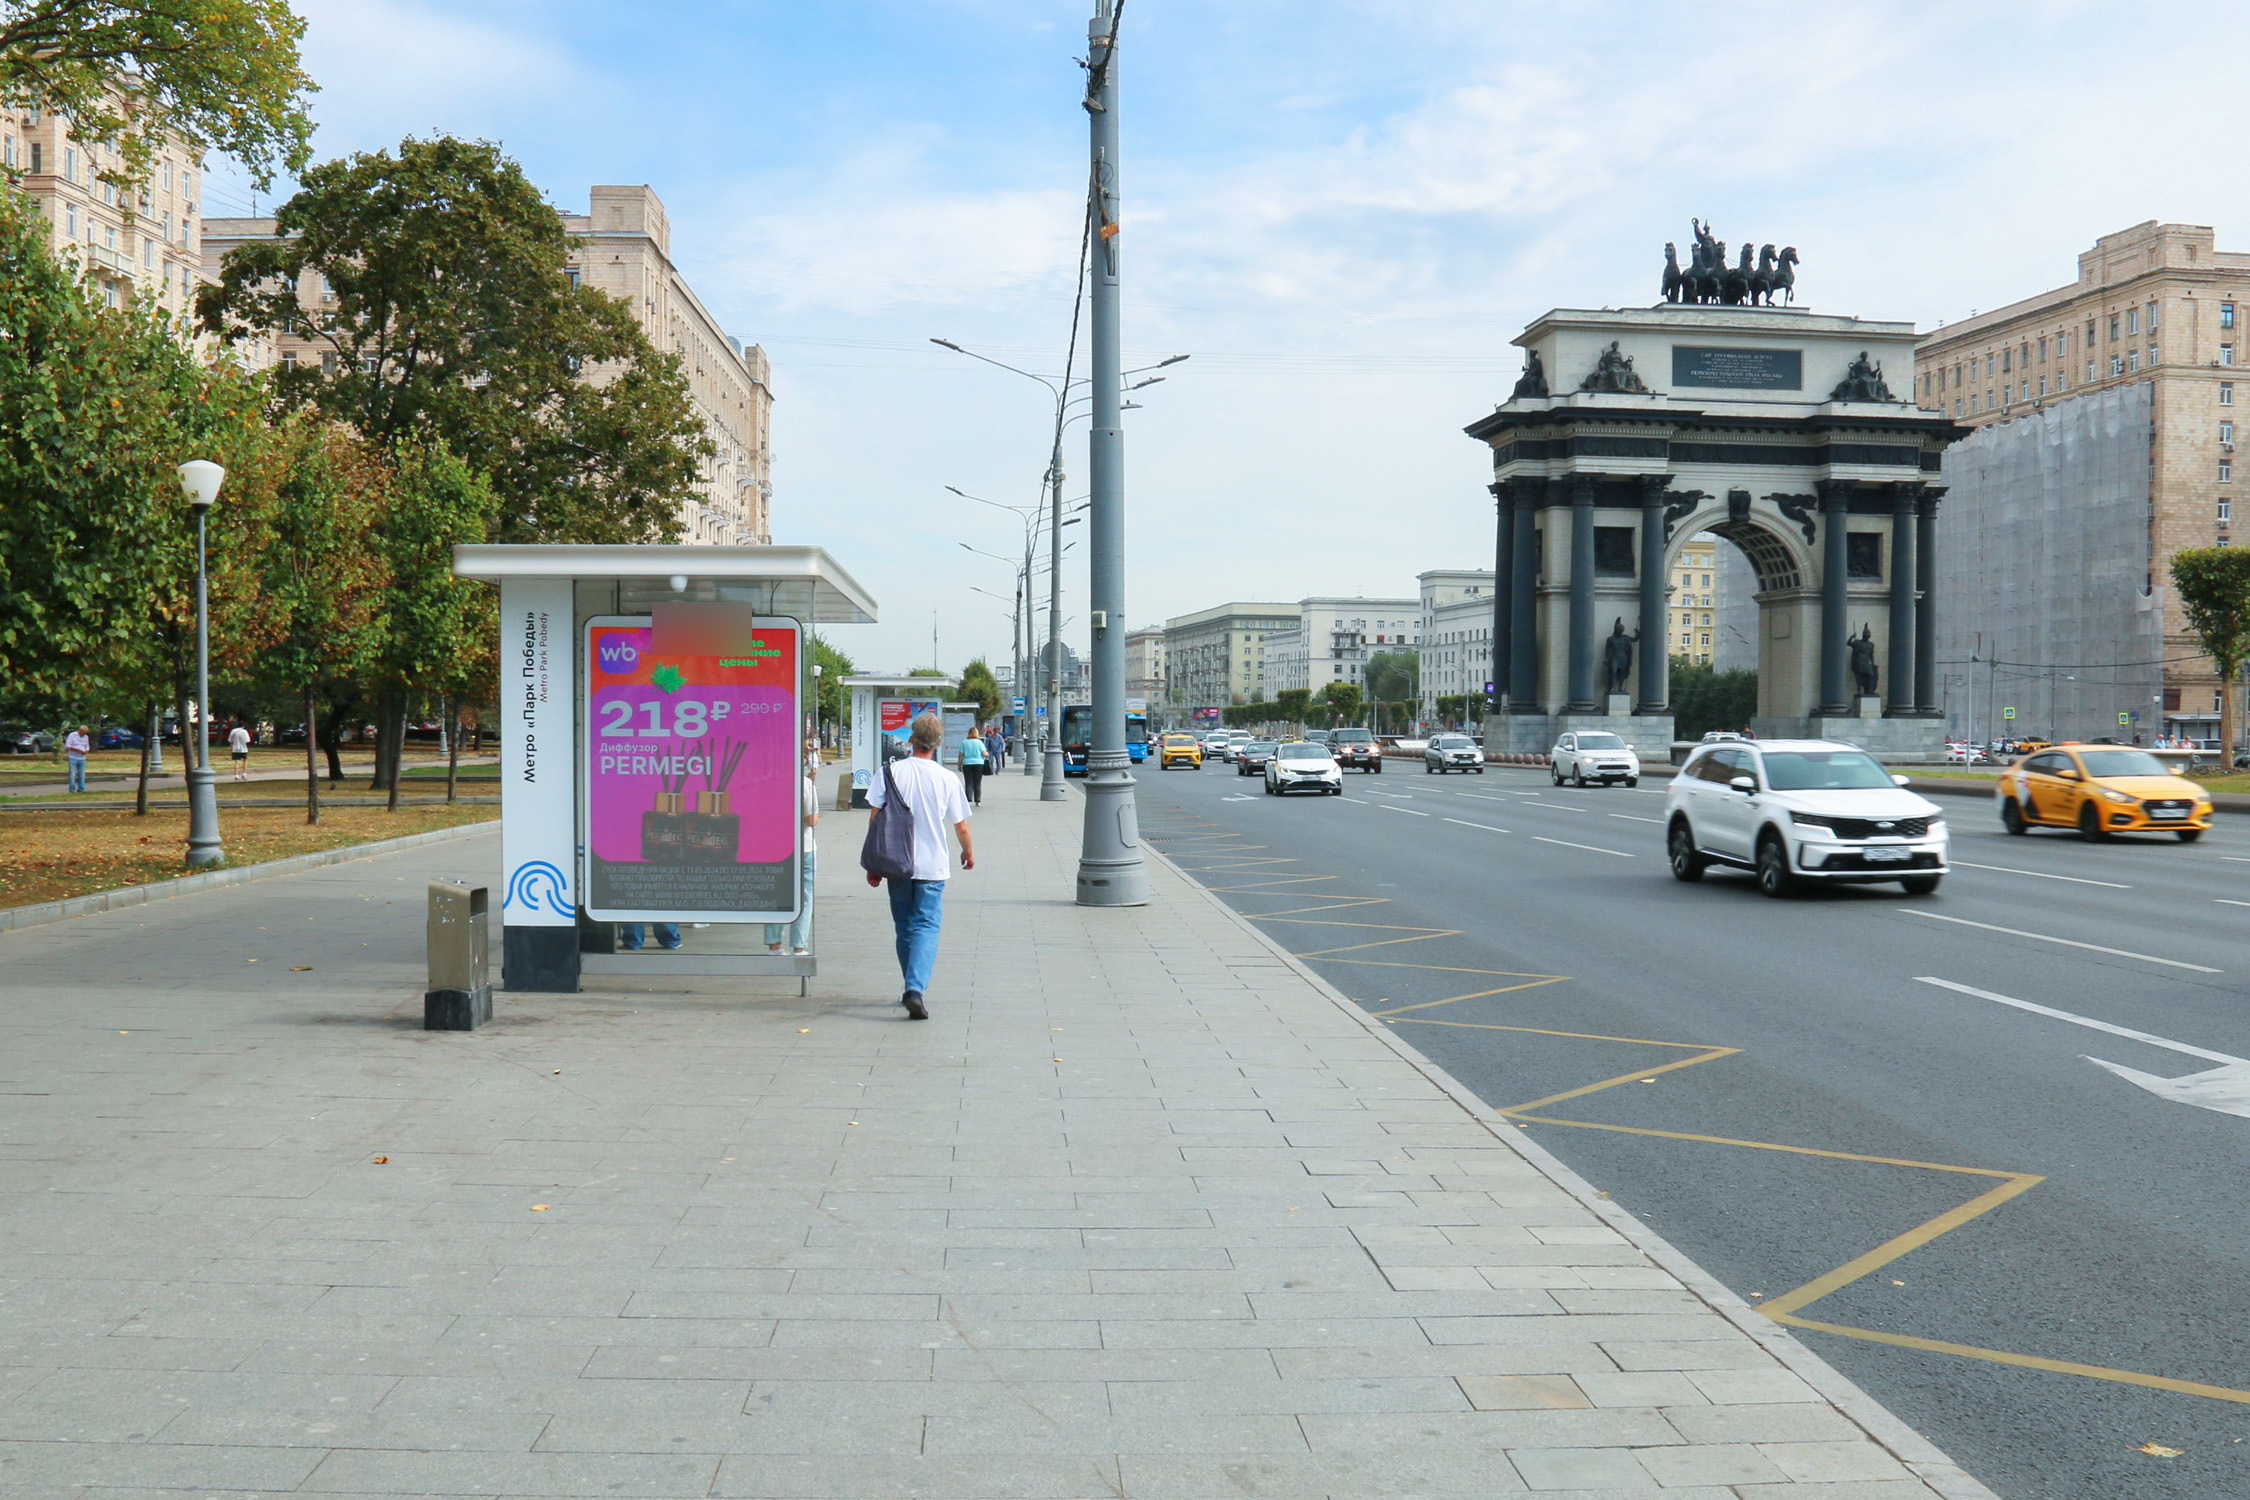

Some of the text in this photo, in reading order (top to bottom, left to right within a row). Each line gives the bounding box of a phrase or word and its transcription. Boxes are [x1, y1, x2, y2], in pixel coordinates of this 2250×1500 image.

[539, 612, 550, 703] Metro Park Pobedy
[600, 642, 638, 662] wb
[718, 658, 758, 668] цены
[522, 612, 538, 783] Метро «Парк Победы»
[600, 742, 658, 754] Диффузор
[600, 756, 712, 776] PERMEGI
